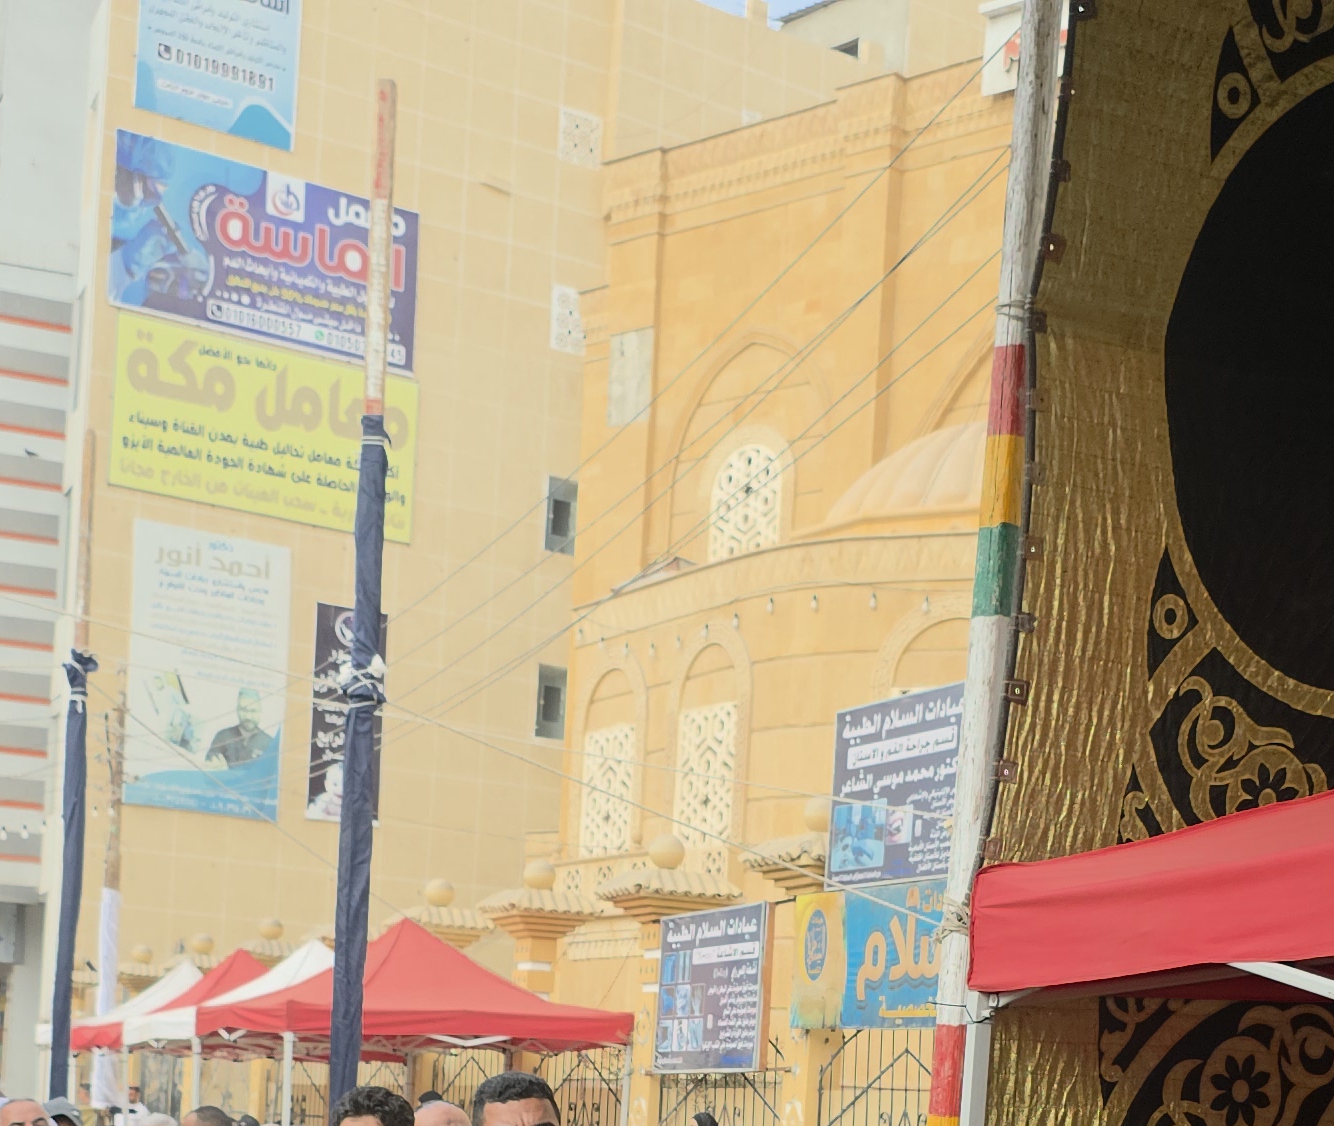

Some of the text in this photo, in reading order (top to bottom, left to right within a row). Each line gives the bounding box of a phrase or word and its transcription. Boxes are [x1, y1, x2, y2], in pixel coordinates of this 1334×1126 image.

[126, 328, 410, 452] معامل مكة
[172, 418, 205, 438] القناة
[156, 440, 203, 464] العالمية
[241, 432, 269, 453] طبية
[271, 440, 305, 461] تحاليل
[205, 449, 244, 471] الجودة
[306, 448, 342, 468] معامل
[841, 713, 882, 745] الطبية
[881, 702, 924, 740] السلام
[905, 763, 935, 783] محمد
[666, 916, 758, 949] عيادات السلام الطبية
